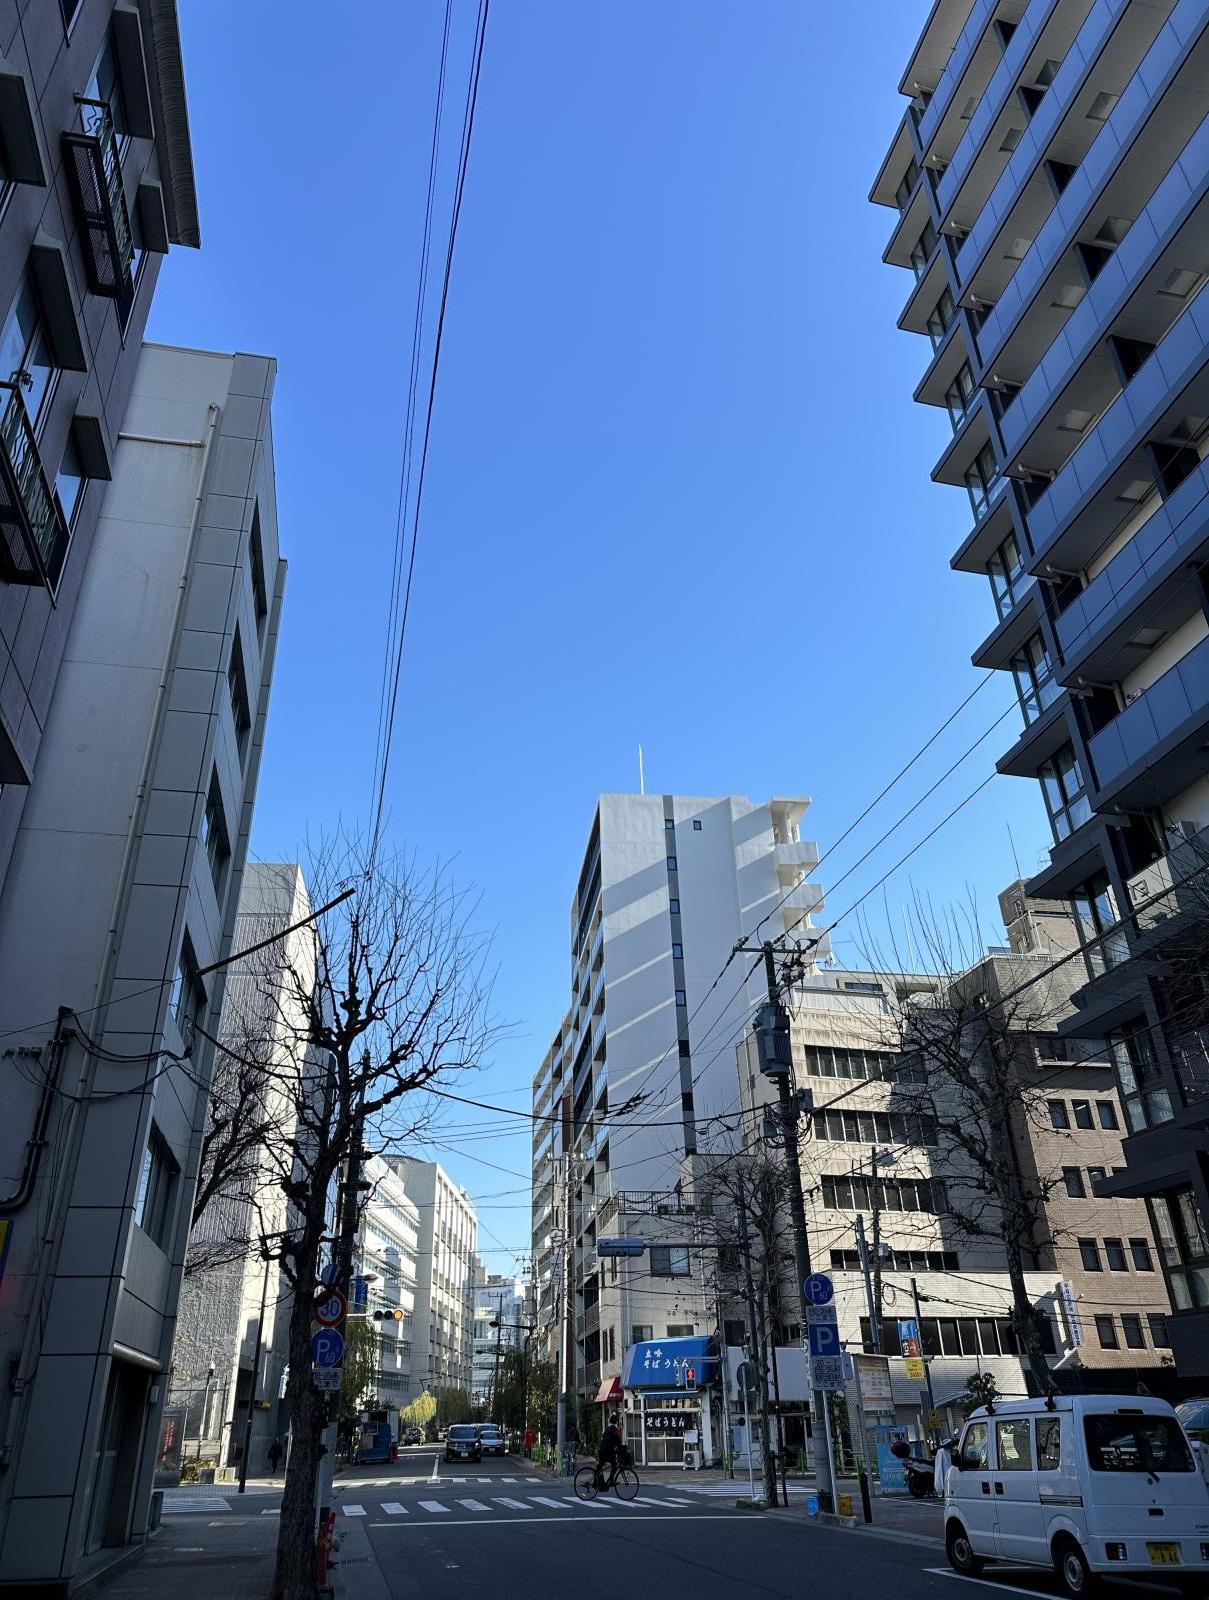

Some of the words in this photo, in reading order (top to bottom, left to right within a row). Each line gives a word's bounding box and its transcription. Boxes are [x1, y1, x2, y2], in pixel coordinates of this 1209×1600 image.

[811, 1281, 822, 1301] P
[320, 1300, 340, 1317] 30
[816, 1327, 834, 1353] P
[317, 1339, 331, 1363] P
[646, 1417, 685, 1427] そばうどん
